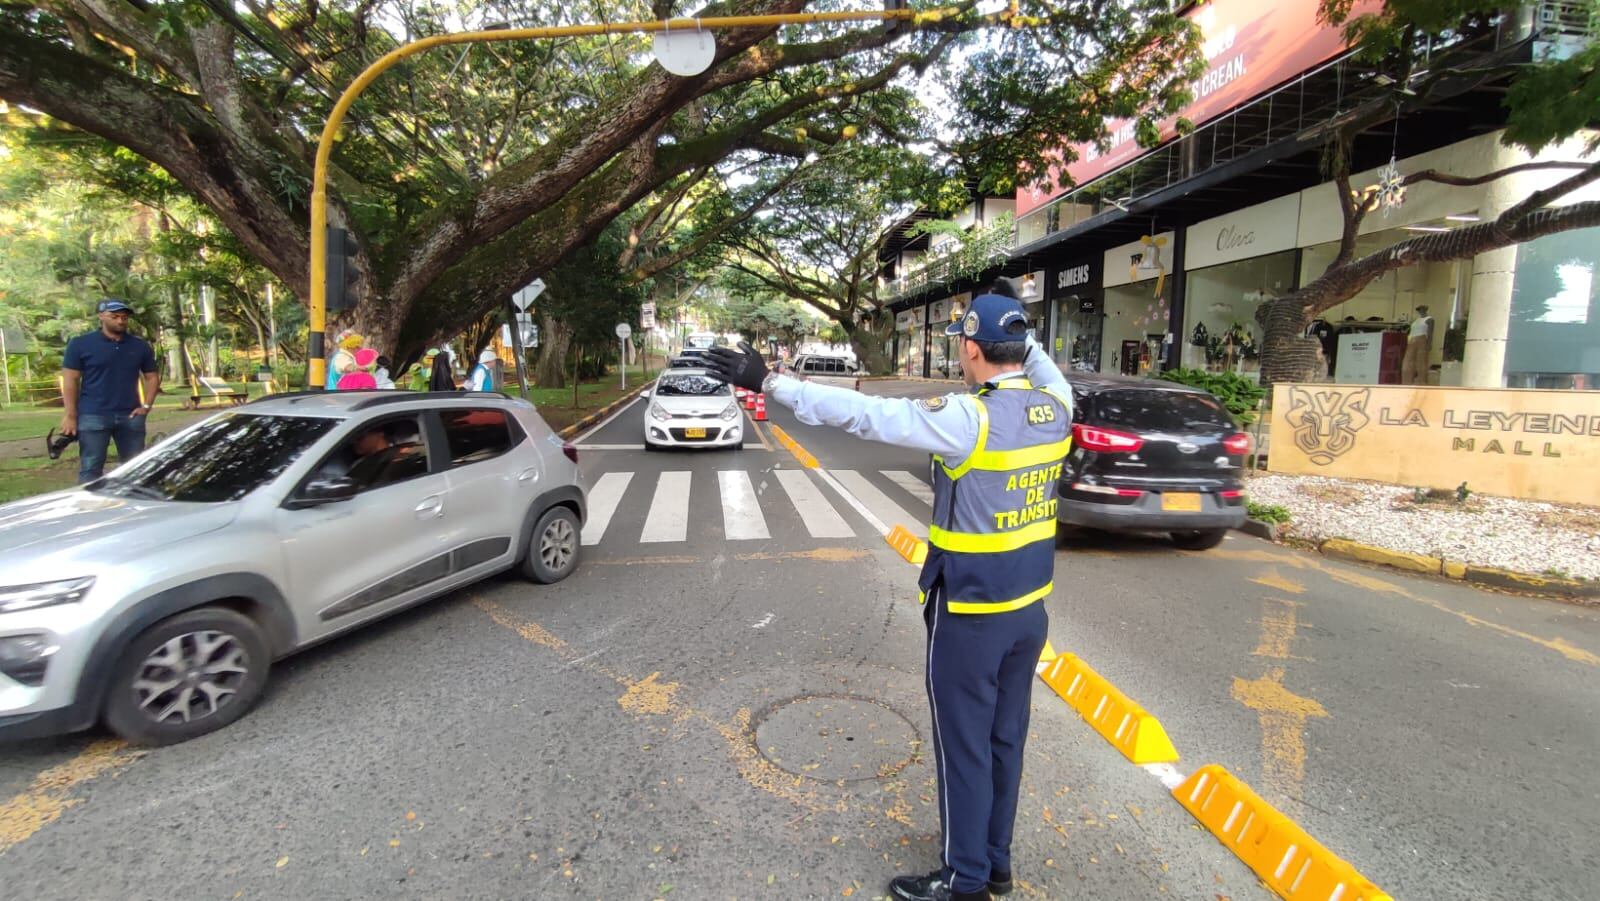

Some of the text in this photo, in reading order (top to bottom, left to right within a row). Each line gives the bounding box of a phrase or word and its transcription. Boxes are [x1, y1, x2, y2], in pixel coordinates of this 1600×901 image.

[1058, 264, 1090, 289] SIMENS
[1028, 405, 1055, 423] 435
[1379, 407, 1430, 427] LA
[1452, 437, 1562, 458] MALL
[1026, 486, 1045, 506] DE
[994, 498, 1058, 529] TRANSIT
